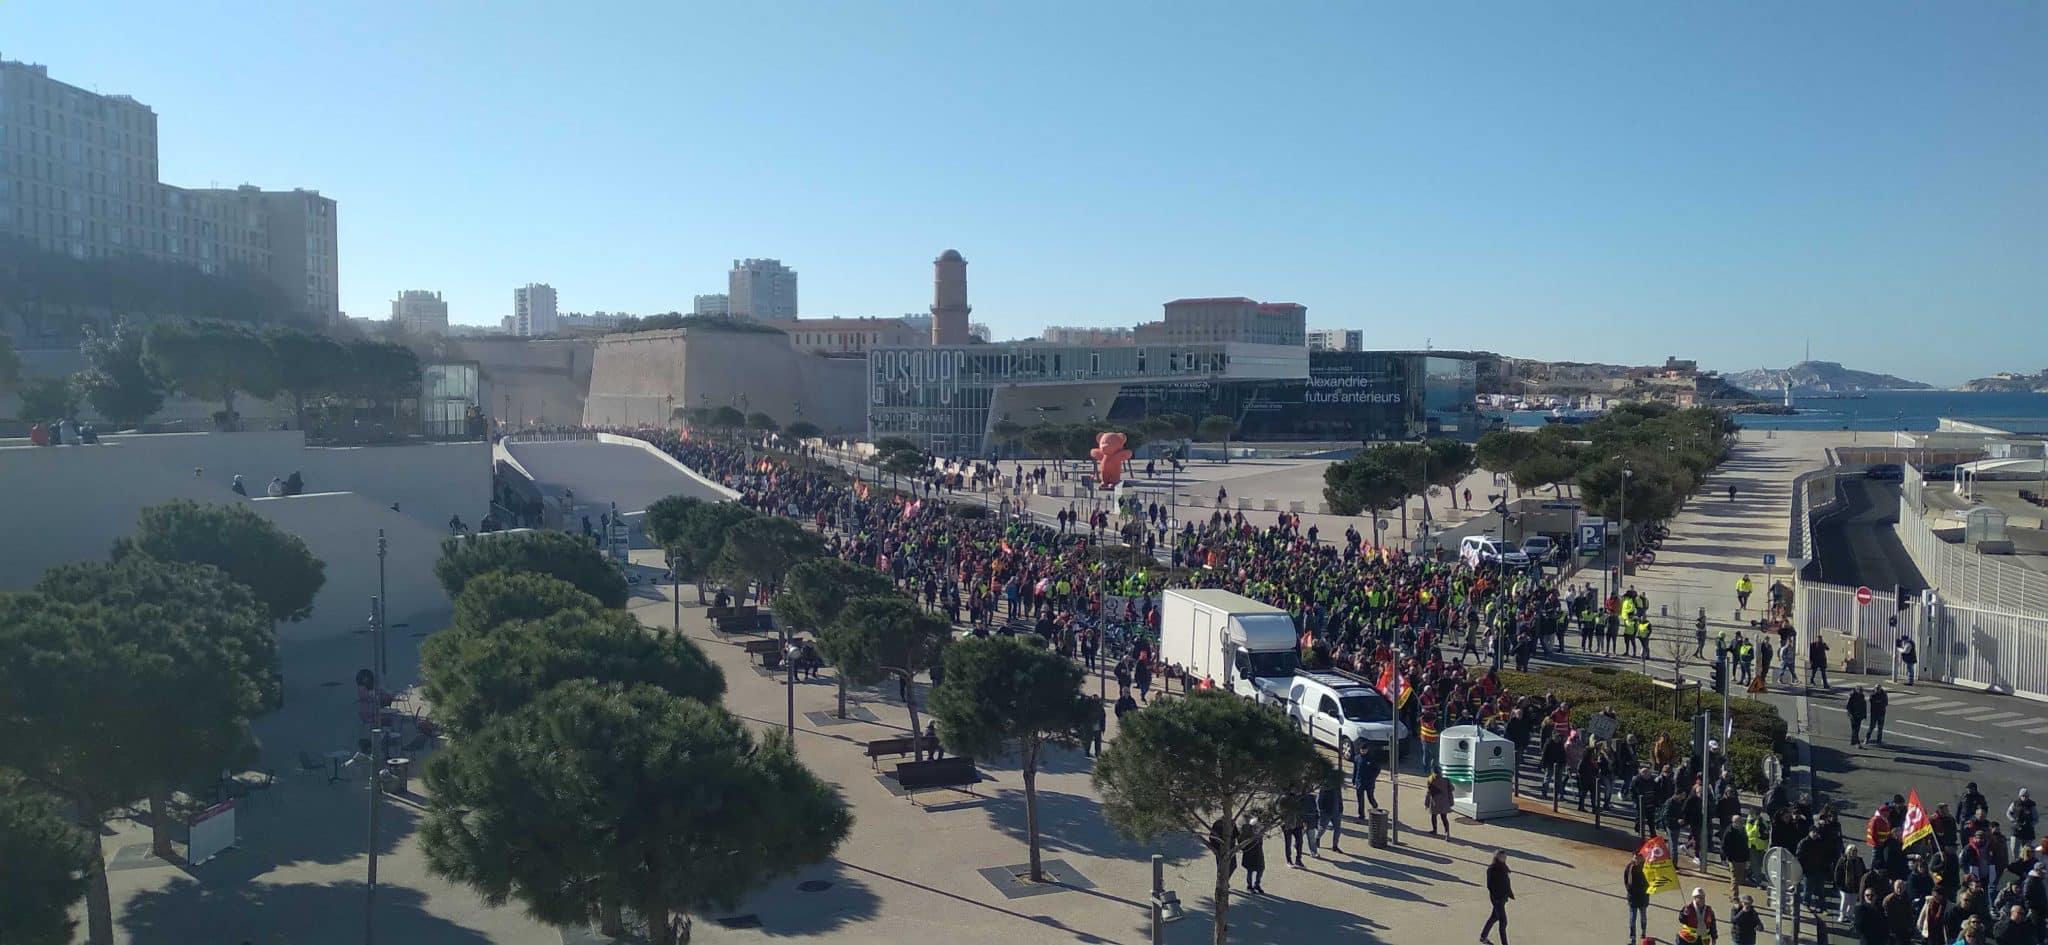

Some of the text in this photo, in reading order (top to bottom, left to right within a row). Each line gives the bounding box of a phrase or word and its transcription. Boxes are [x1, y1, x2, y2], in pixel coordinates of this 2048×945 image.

[1305, 376, 1368, 387] Alexandrie
[1305, 390, 1401, 403] futurs antérieurs
[1583, 527, 1595, 543] P
